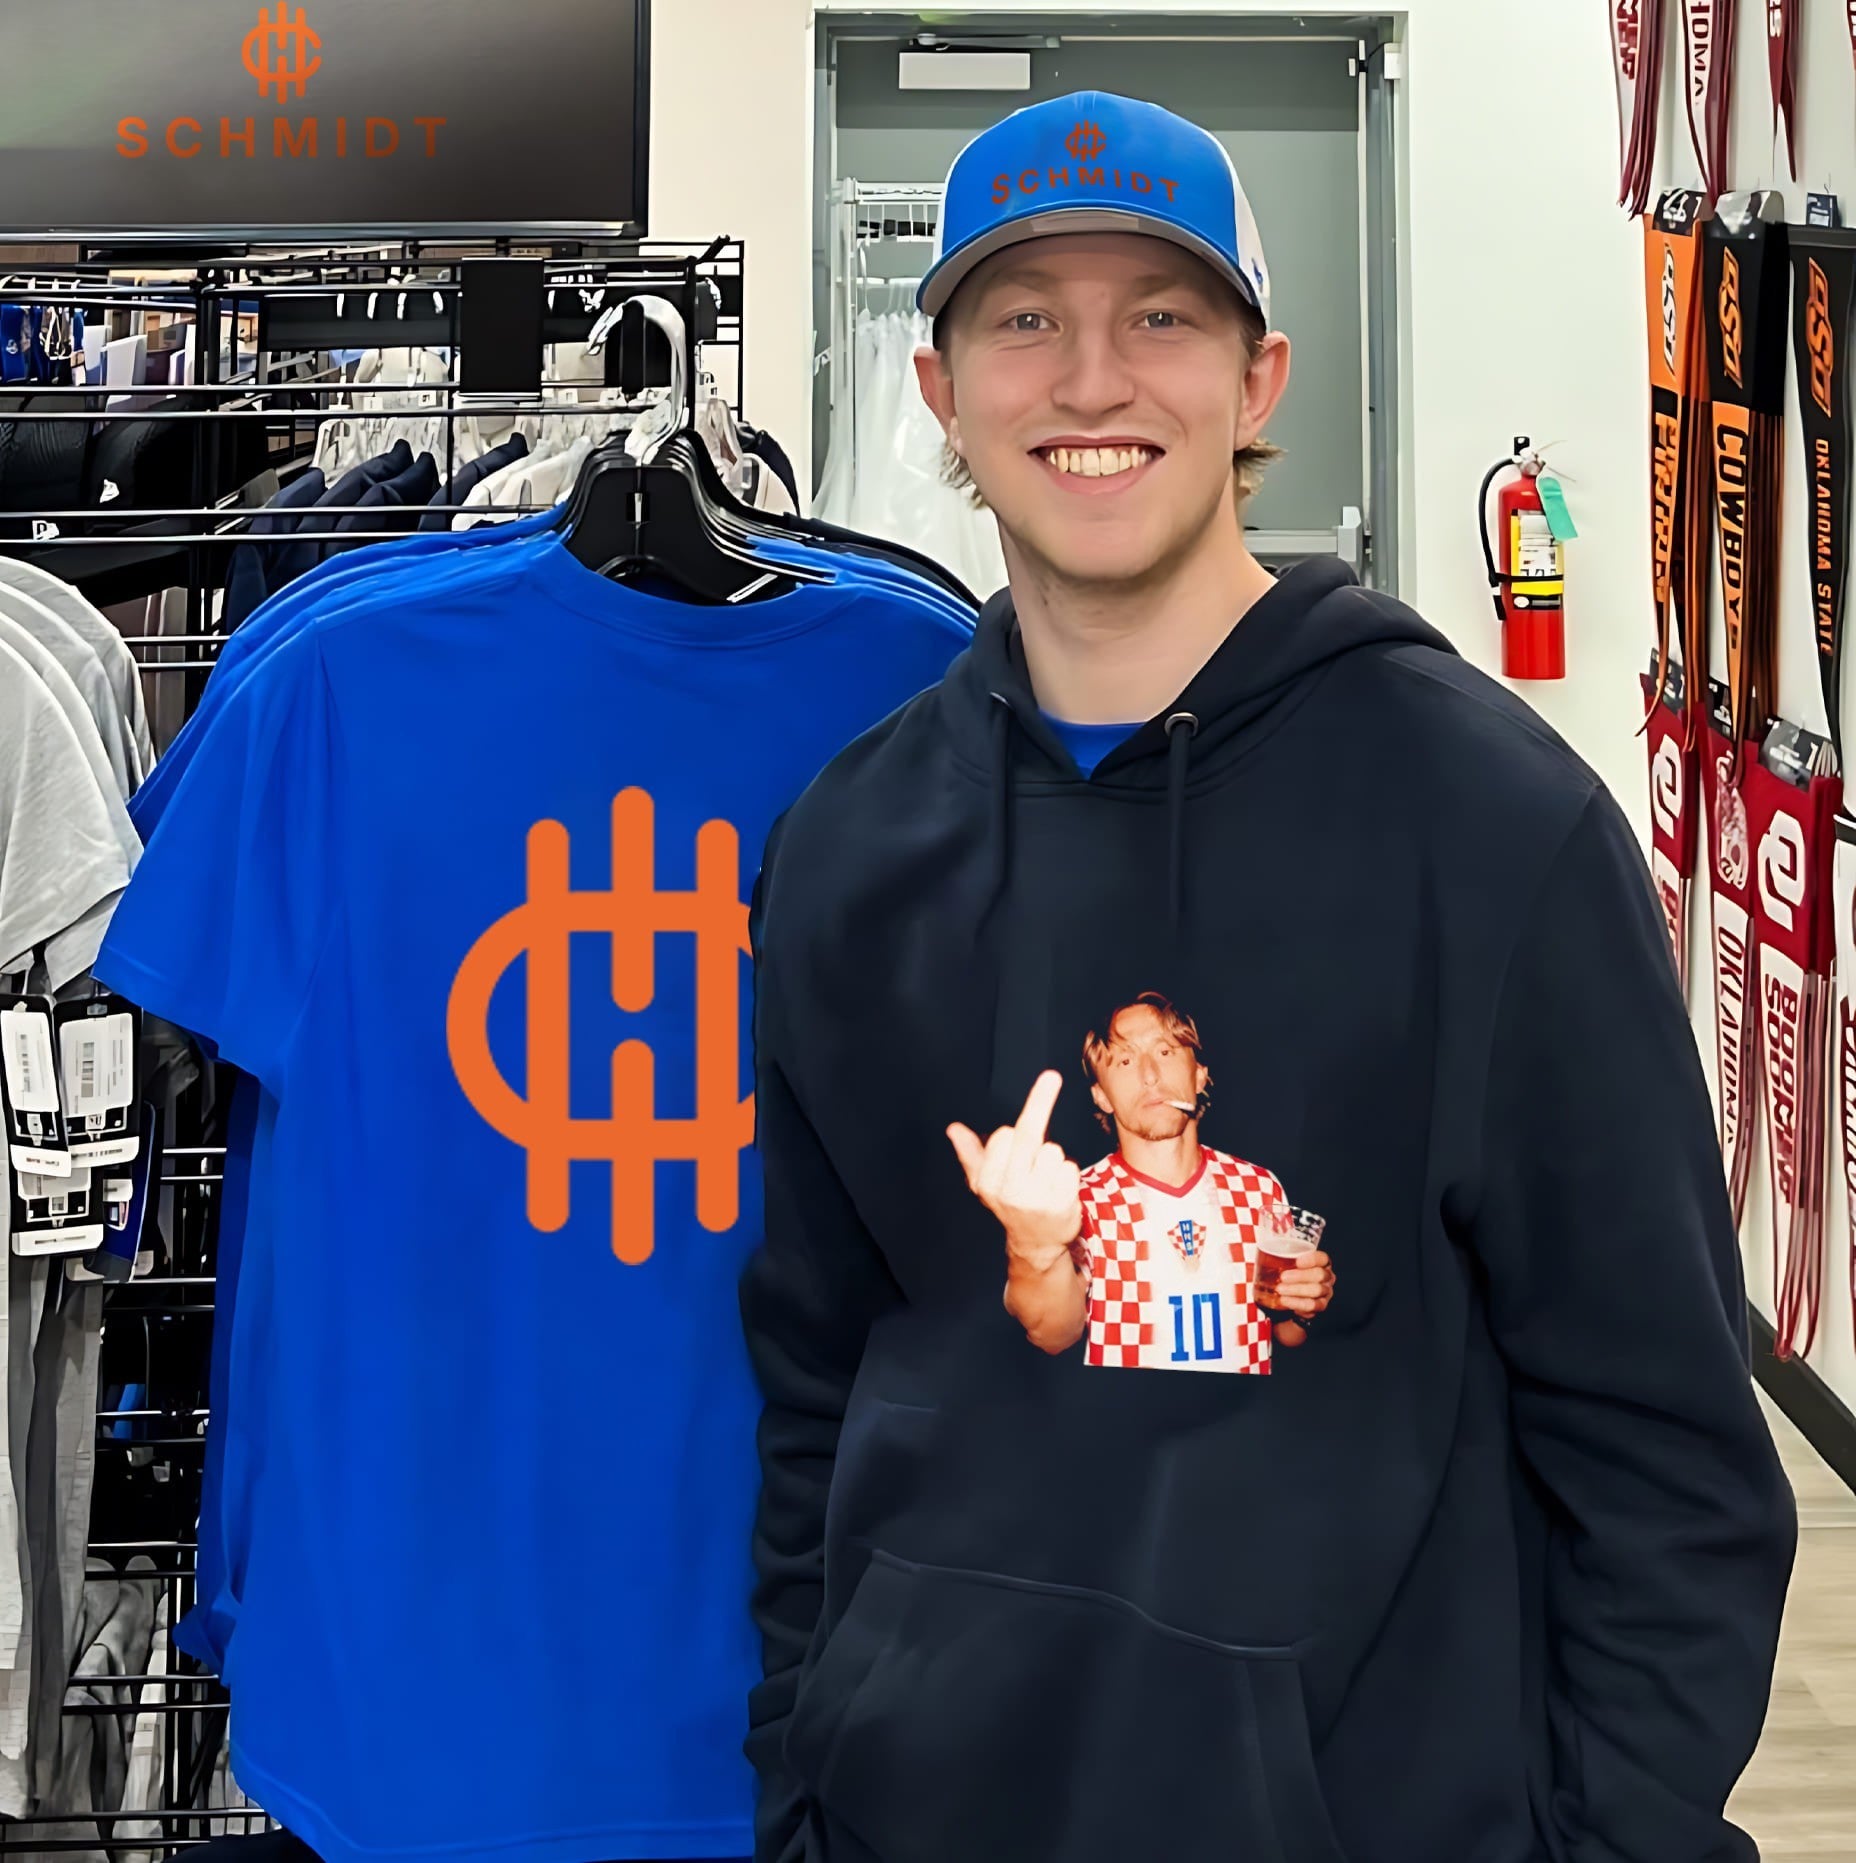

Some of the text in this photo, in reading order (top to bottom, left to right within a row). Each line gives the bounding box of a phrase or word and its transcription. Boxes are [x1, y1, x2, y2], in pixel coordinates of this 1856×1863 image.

[115, 116, 447, 159] SCHMIDT
[991, 166, 1179, 204] SCHMIDT
[1815, 438, 1832, 570] OKLAHOMA
[1718, 926, 1745, 1144] OKLAHOMA
[1168, 1293, 1223, 1361] 10
